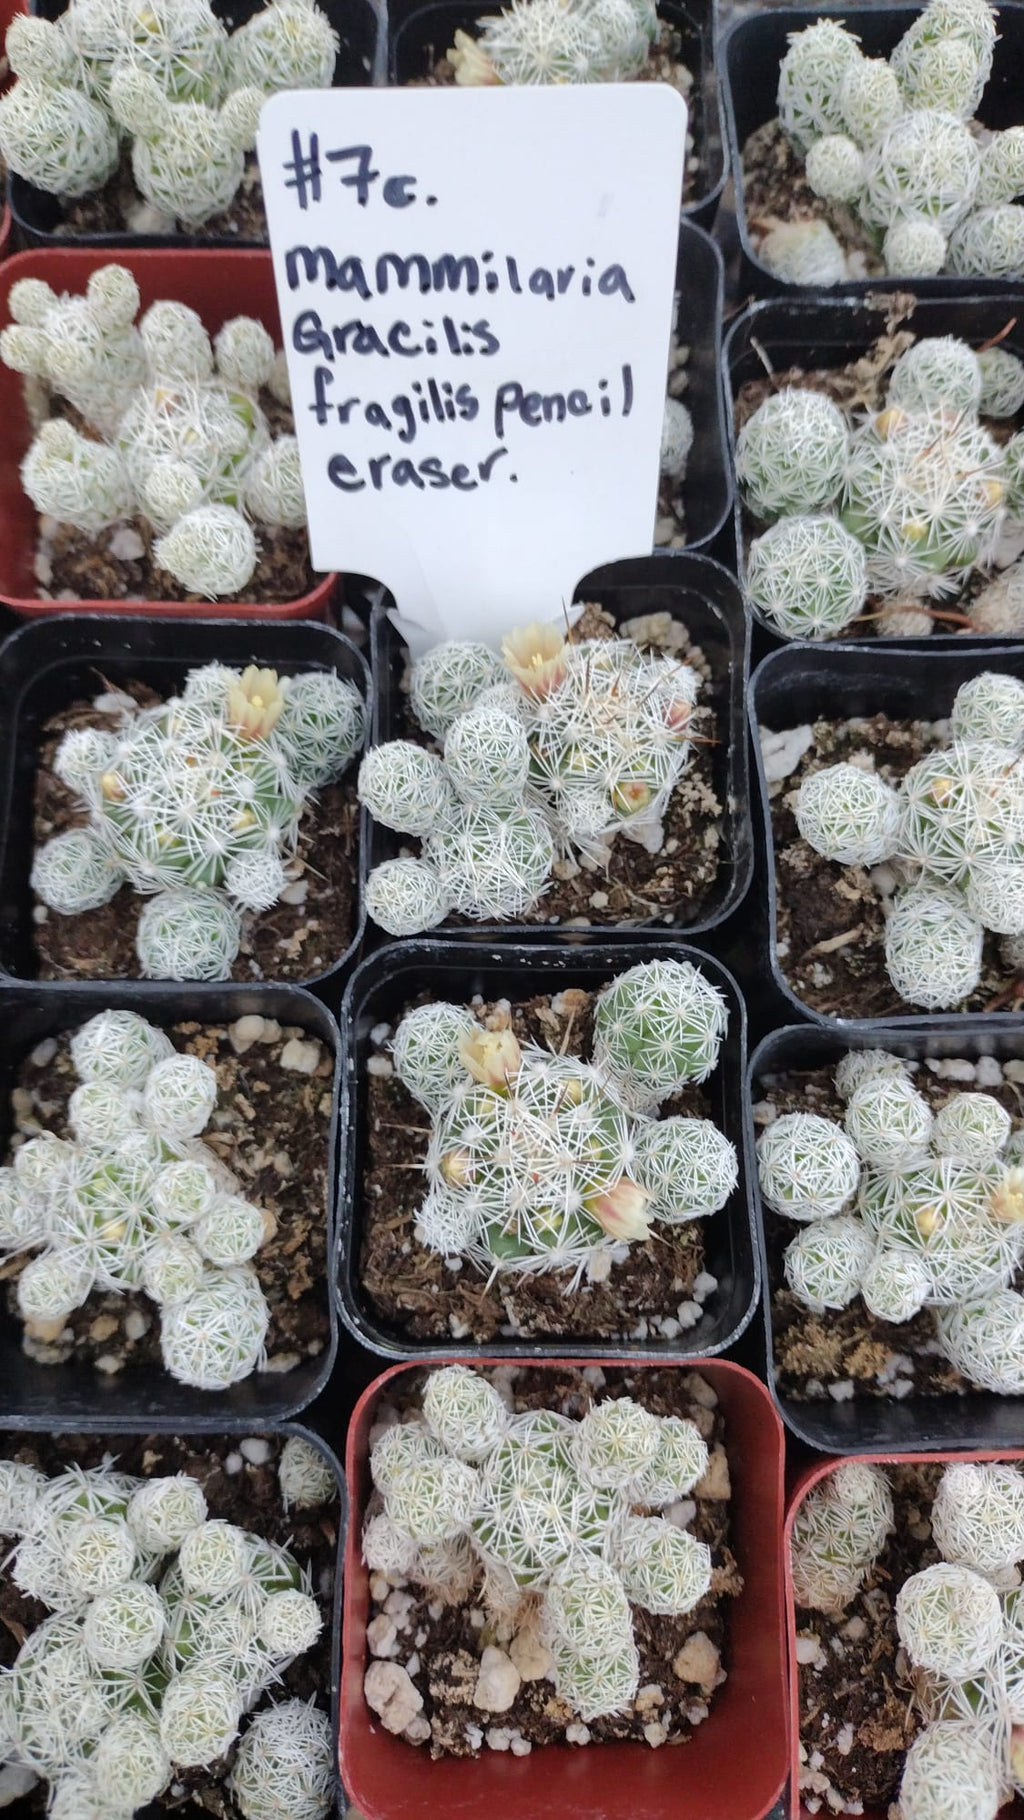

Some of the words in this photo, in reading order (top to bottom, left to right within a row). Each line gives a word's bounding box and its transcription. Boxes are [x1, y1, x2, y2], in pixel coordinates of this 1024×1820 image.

[291, 309, 501, 362] Gracilis
[308, 365, 480, 443] fragilis
[493, 363, 634, 440] pencil
